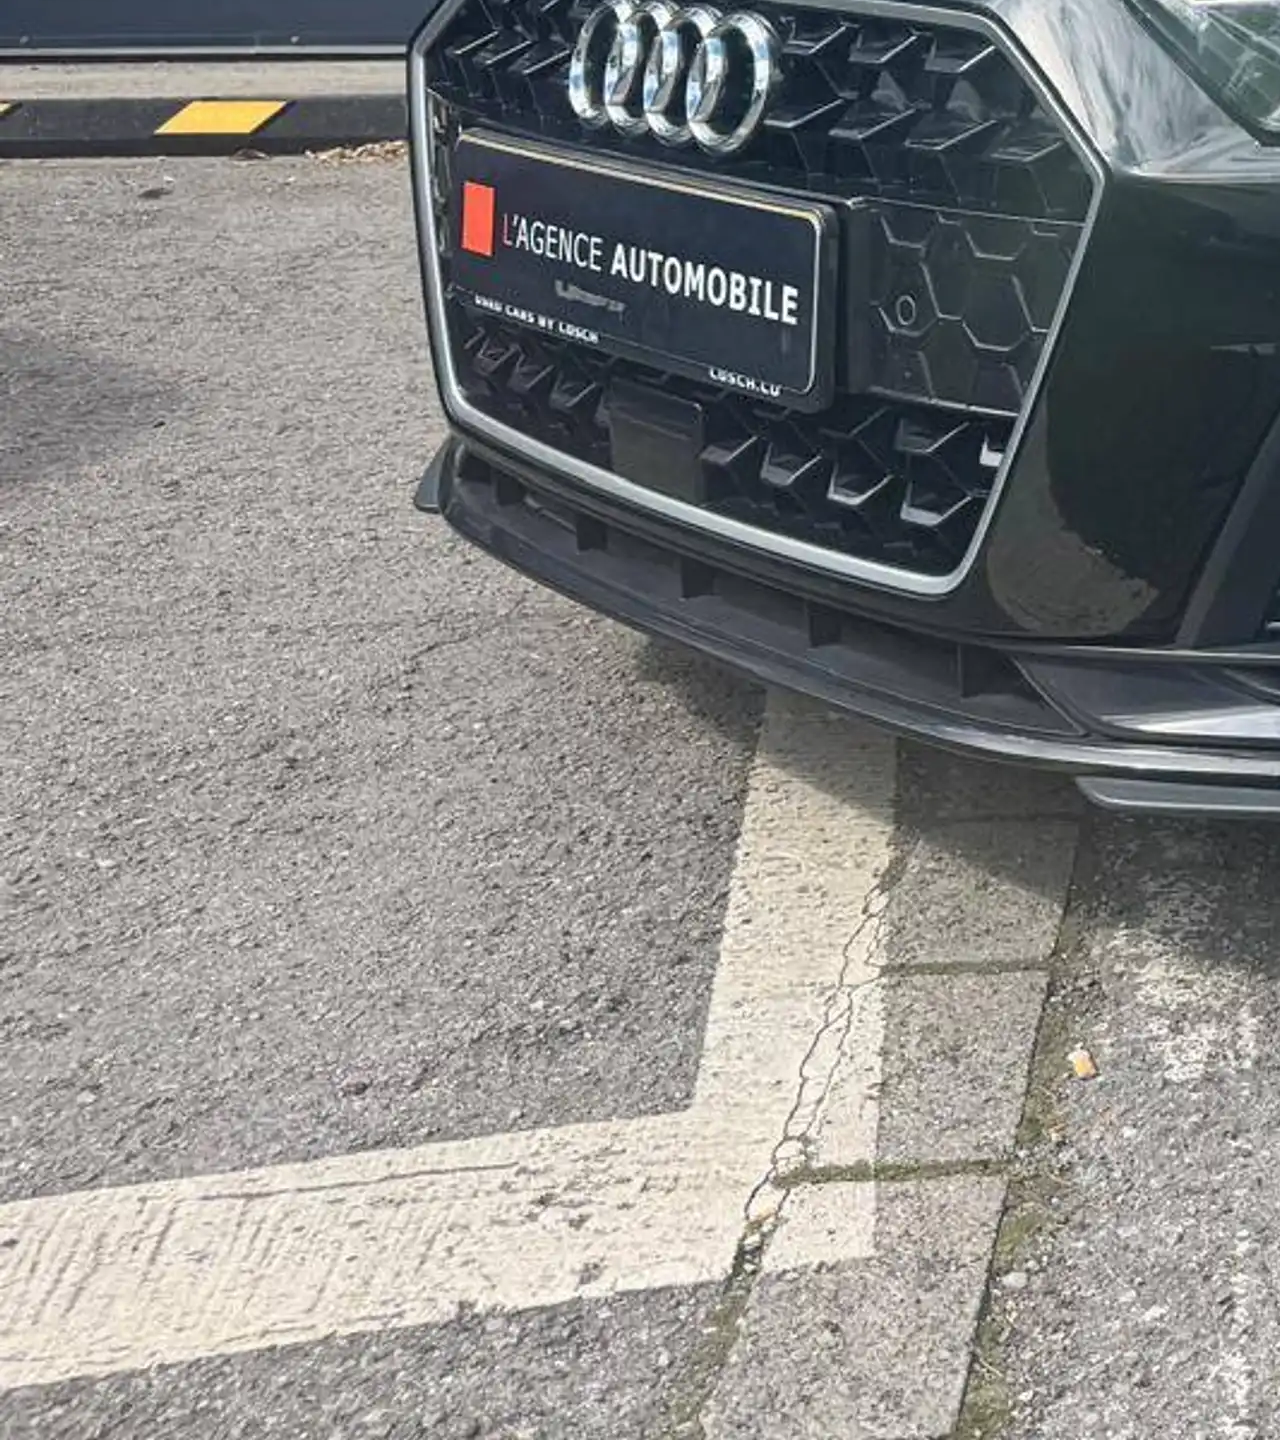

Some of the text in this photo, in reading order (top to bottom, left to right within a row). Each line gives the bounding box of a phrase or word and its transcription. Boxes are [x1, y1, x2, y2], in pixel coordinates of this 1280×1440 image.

[502, 212, 604, 272] L'AGENCE
[610, 242, 800, 326] AUTOMOBILE
[504, 303, 536, 325] CARS
